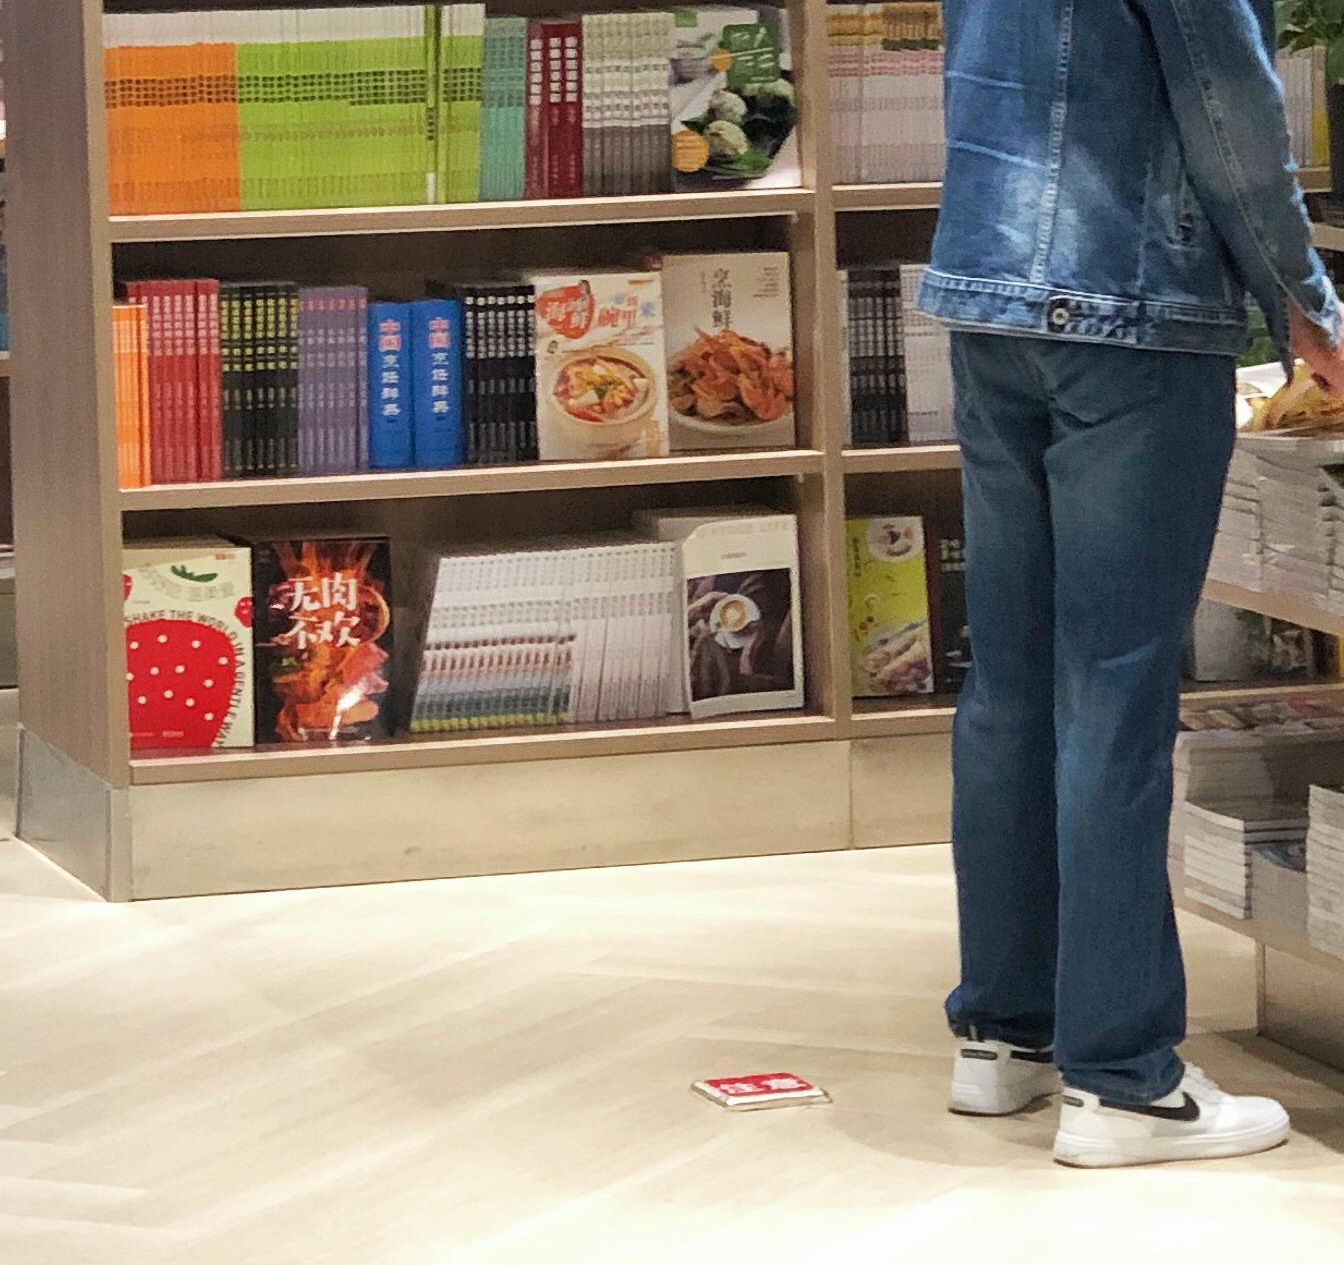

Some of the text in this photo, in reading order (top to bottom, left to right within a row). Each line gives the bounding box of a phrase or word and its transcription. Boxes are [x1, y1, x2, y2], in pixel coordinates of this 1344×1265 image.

[287, 571, 358, 611] 无肉
[169, 609, 193, 619] THE
[196, 613, 239, 640] WORLD
[287, 611, 361, 650] 不欢
